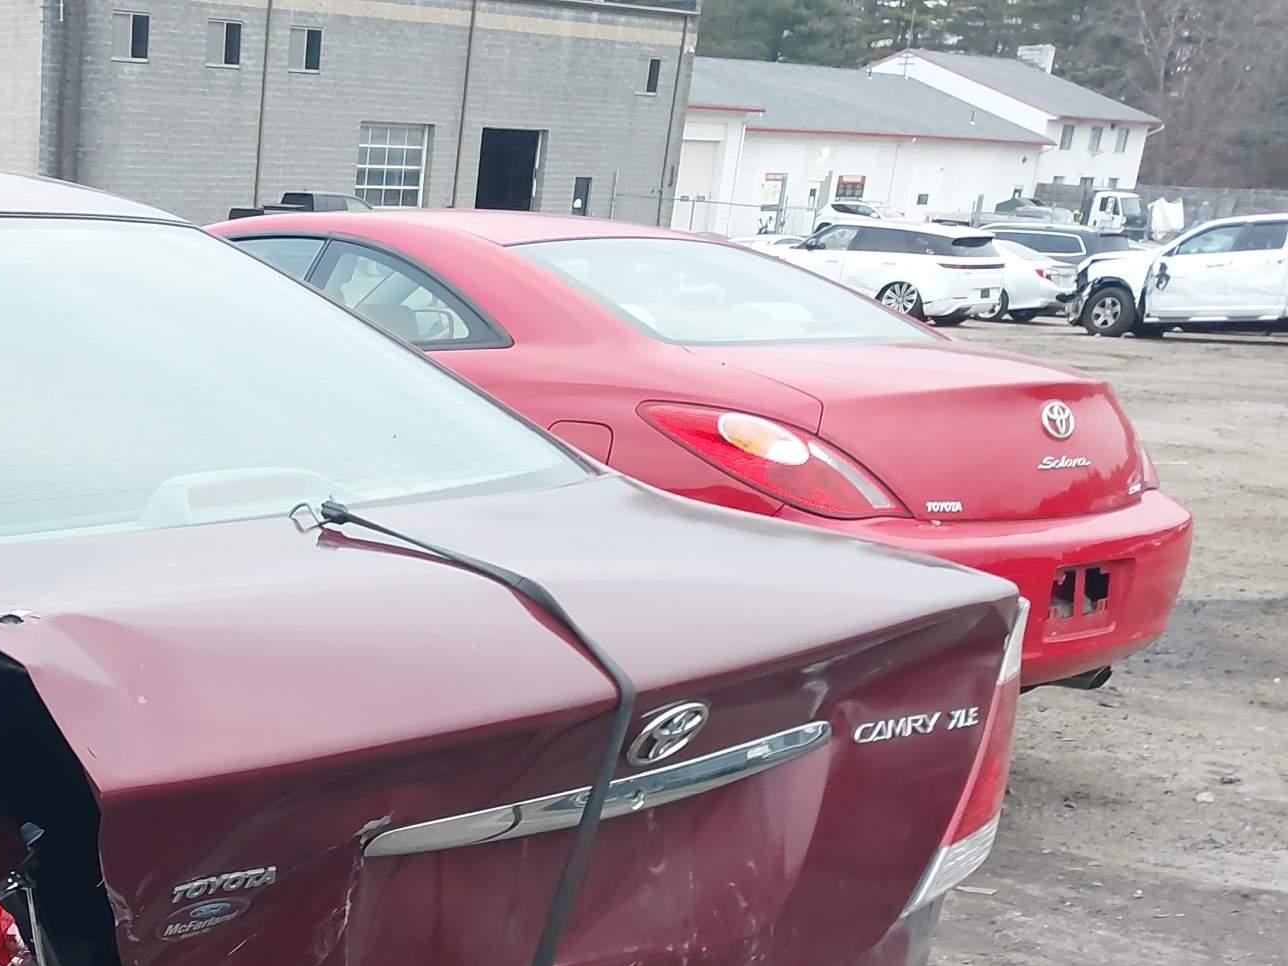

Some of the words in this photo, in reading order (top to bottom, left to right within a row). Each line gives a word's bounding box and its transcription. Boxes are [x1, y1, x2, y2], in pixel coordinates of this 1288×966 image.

[926, 501, 963, 512] TOYOTA
[853, 711, 942, 744] CAMRY
[171, 866, 277, 903] TOYOTA
